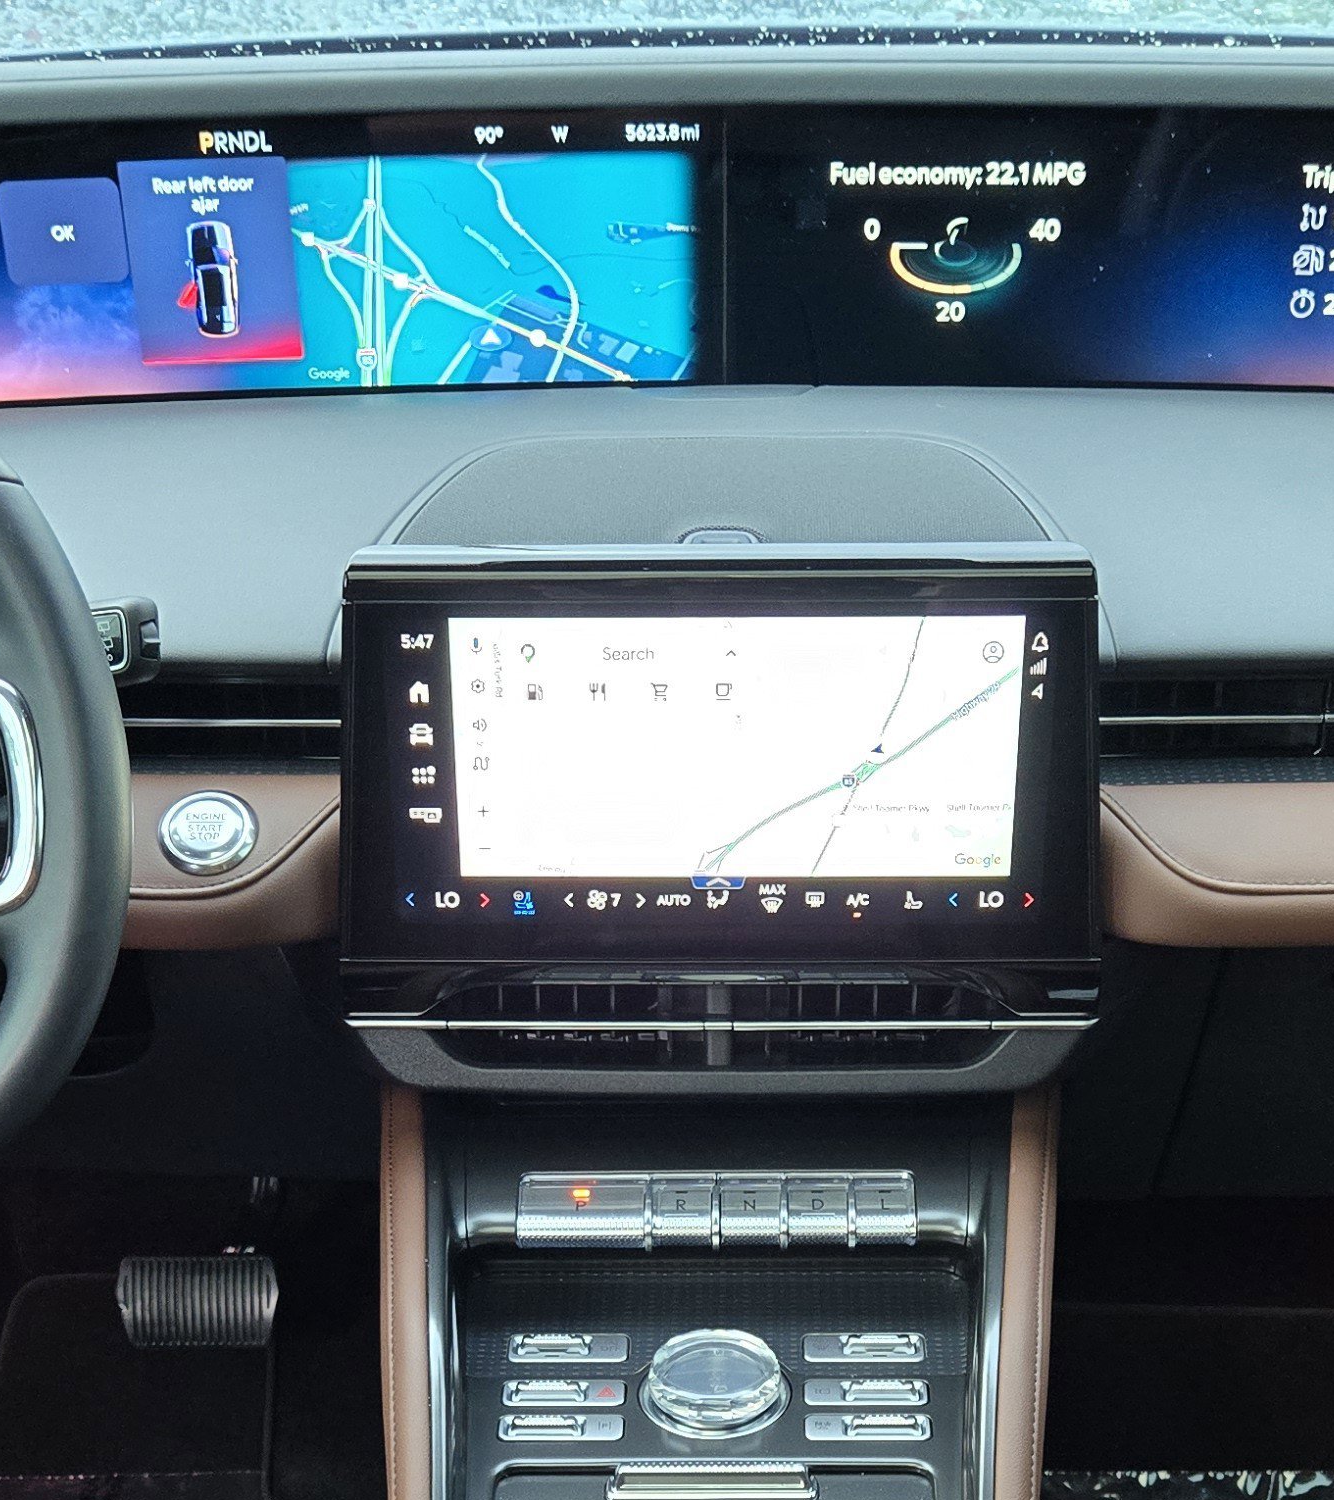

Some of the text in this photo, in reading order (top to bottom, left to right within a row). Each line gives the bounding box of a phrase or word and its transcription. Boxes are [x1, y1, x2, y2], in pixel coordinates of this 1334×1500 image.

[199, 130, 273, 154] PRNDL
[551, 125, 569, 143] W
[830, 162, 1087, 190] Fuel economy: 22.1 MPG
[151, 175, 255, 195] Rear left door
[191, 195, 220, 216] ajar
[50, 224, 76, 242] OK
[863, 217, 882, 241] 0
[1028, 217, 1062, 242] 40
[935, 301, 966, 323] 20
[308, 366, 351, 382] Google
[400, 634, 435, 650] 5:47
[602, 646, 655, 661] Search
[185, 812, 226, 821] ENGINE
[187, 824, 224, 832] START
[188, 832, 220, 841] STOP
[954, 853, 1001, 868] Google
[758, 883, 786, 896] MAX
[435, 891, 461, 909] LO
[610, 893, 622, 907] 7
[656, 894, 692, 907] AUTO
[846, 893, 870, 907] A/C
[978, 891, 1005, 909] LO
[575, 1199, 890, 1212] P R N D L
